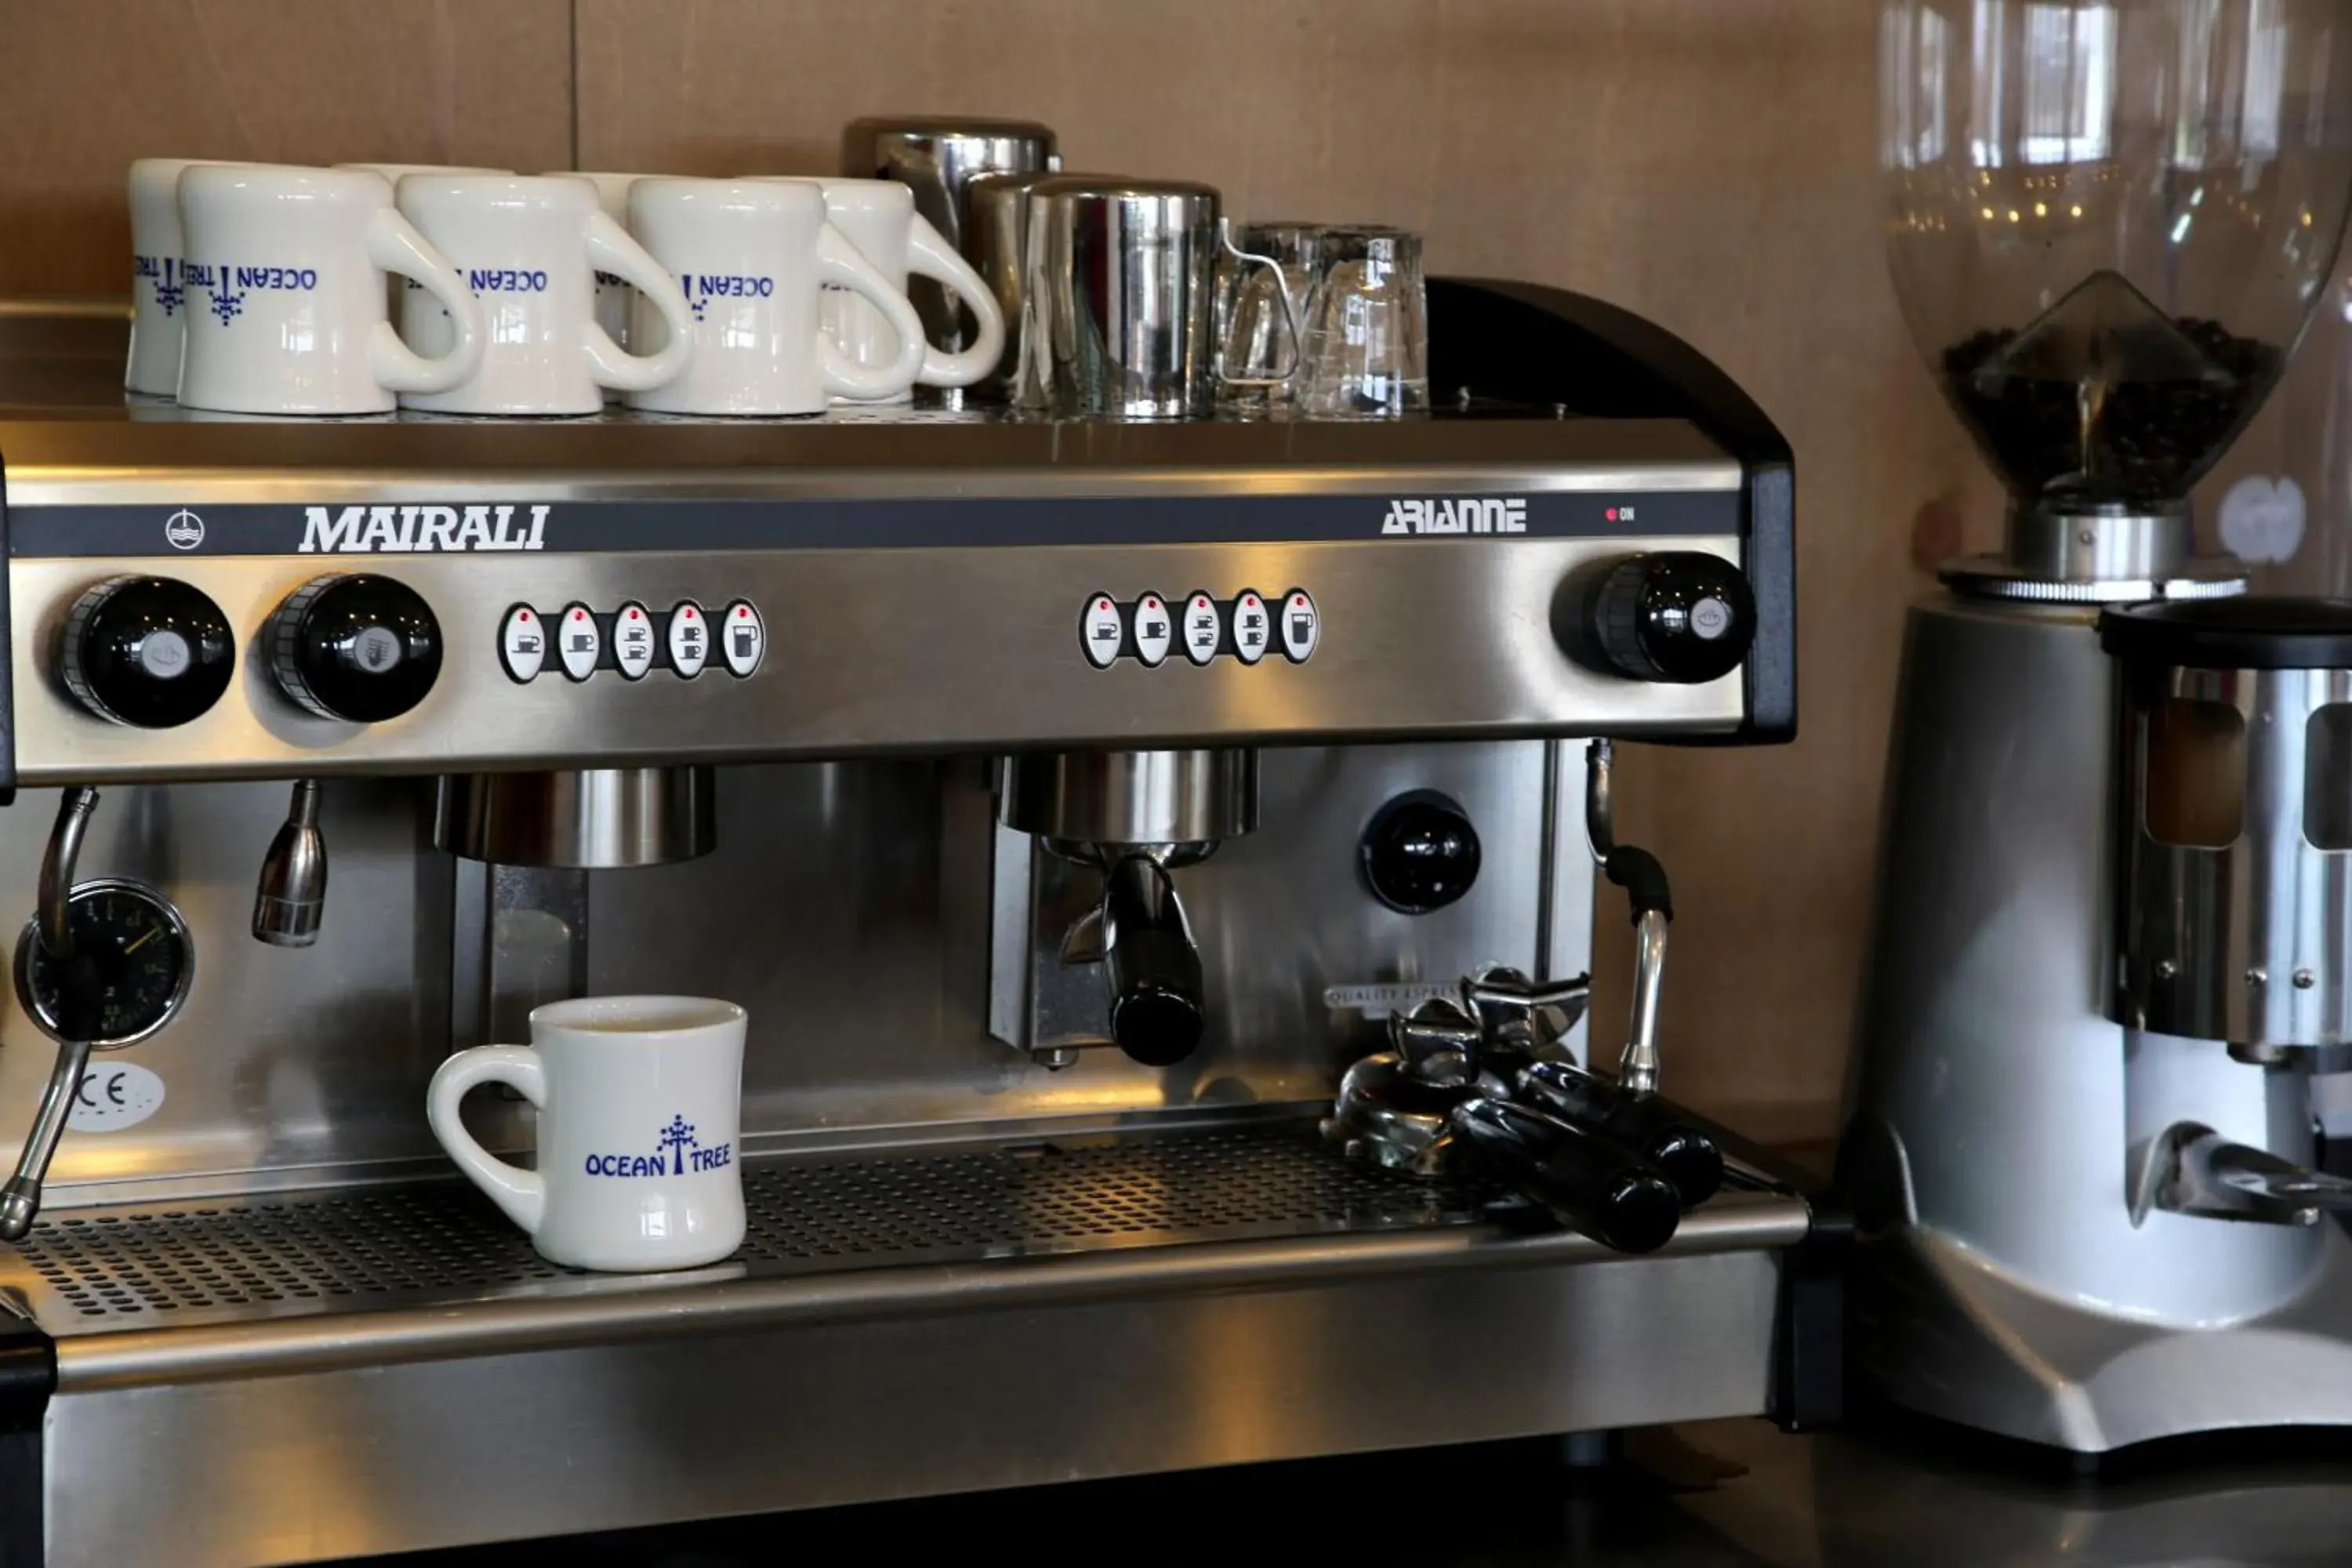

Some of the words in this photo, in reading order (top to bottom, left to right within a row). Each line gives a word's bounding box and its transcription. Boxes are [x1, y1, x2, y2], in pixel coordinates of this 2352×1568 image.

[237, 267, 317, 290] OCEAN
[470, 270, 547, 292] OCEAN
[700, 275, 774, 297] OCEAN
[1381, 499, 1526, 534] ARIANNE
[1619, 507, 1635, 521] ON
[298, 506, 550, 552] MAIRALI
[1330, 988, 1396, 1003] QUALITY
[1404, 985, 1457, 1000] ESPRES
[78, 1072, 126, 1107] CE
[586, 1154, 666, 1177] OCEAN
[690, 1143, 731, 1172] TREE
